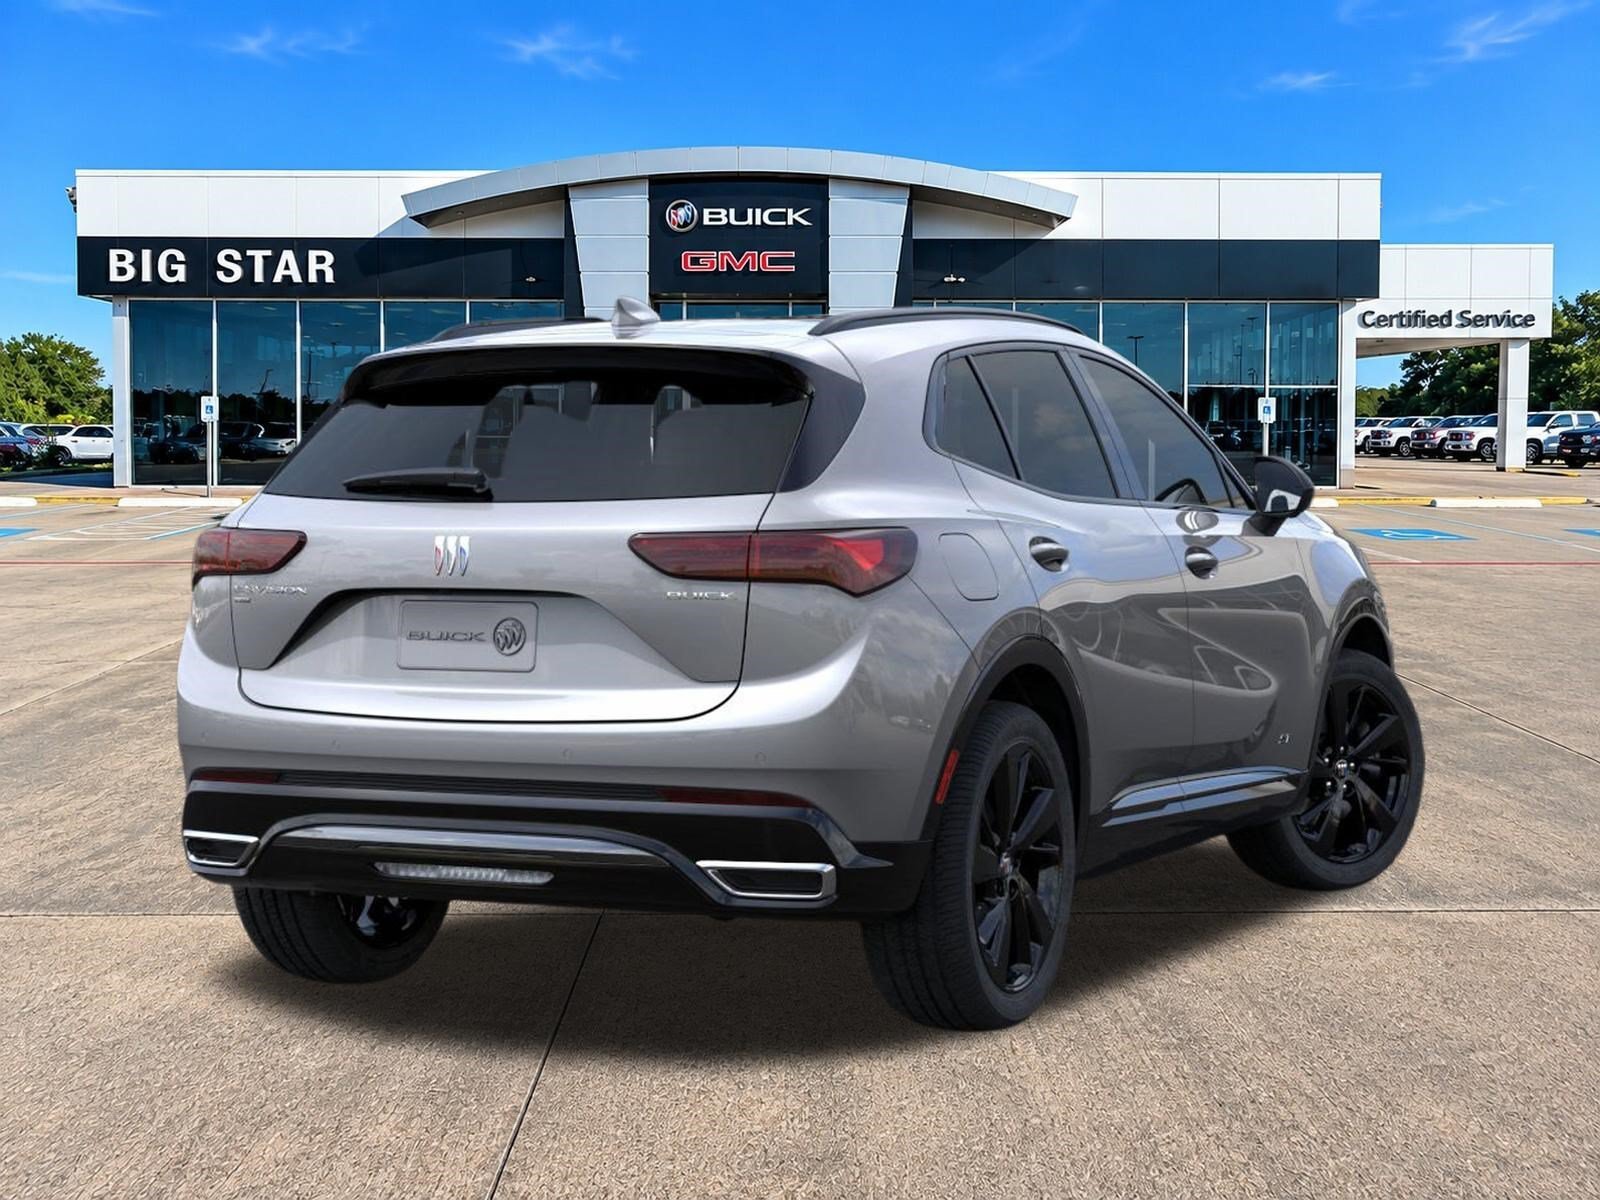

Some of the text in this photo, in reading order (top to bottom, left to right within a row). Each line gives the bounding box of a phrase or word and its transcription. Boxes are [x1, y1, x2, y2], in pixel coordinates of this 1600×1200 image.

[702, 207, 813, 226] BUICK
[108, 248, 336, 283] BIG STAR
[681, 250, 796, 272] GMC
[1359, 309, 1537, 328] Certified Service
[406, 630, 487, 642] BUICK
